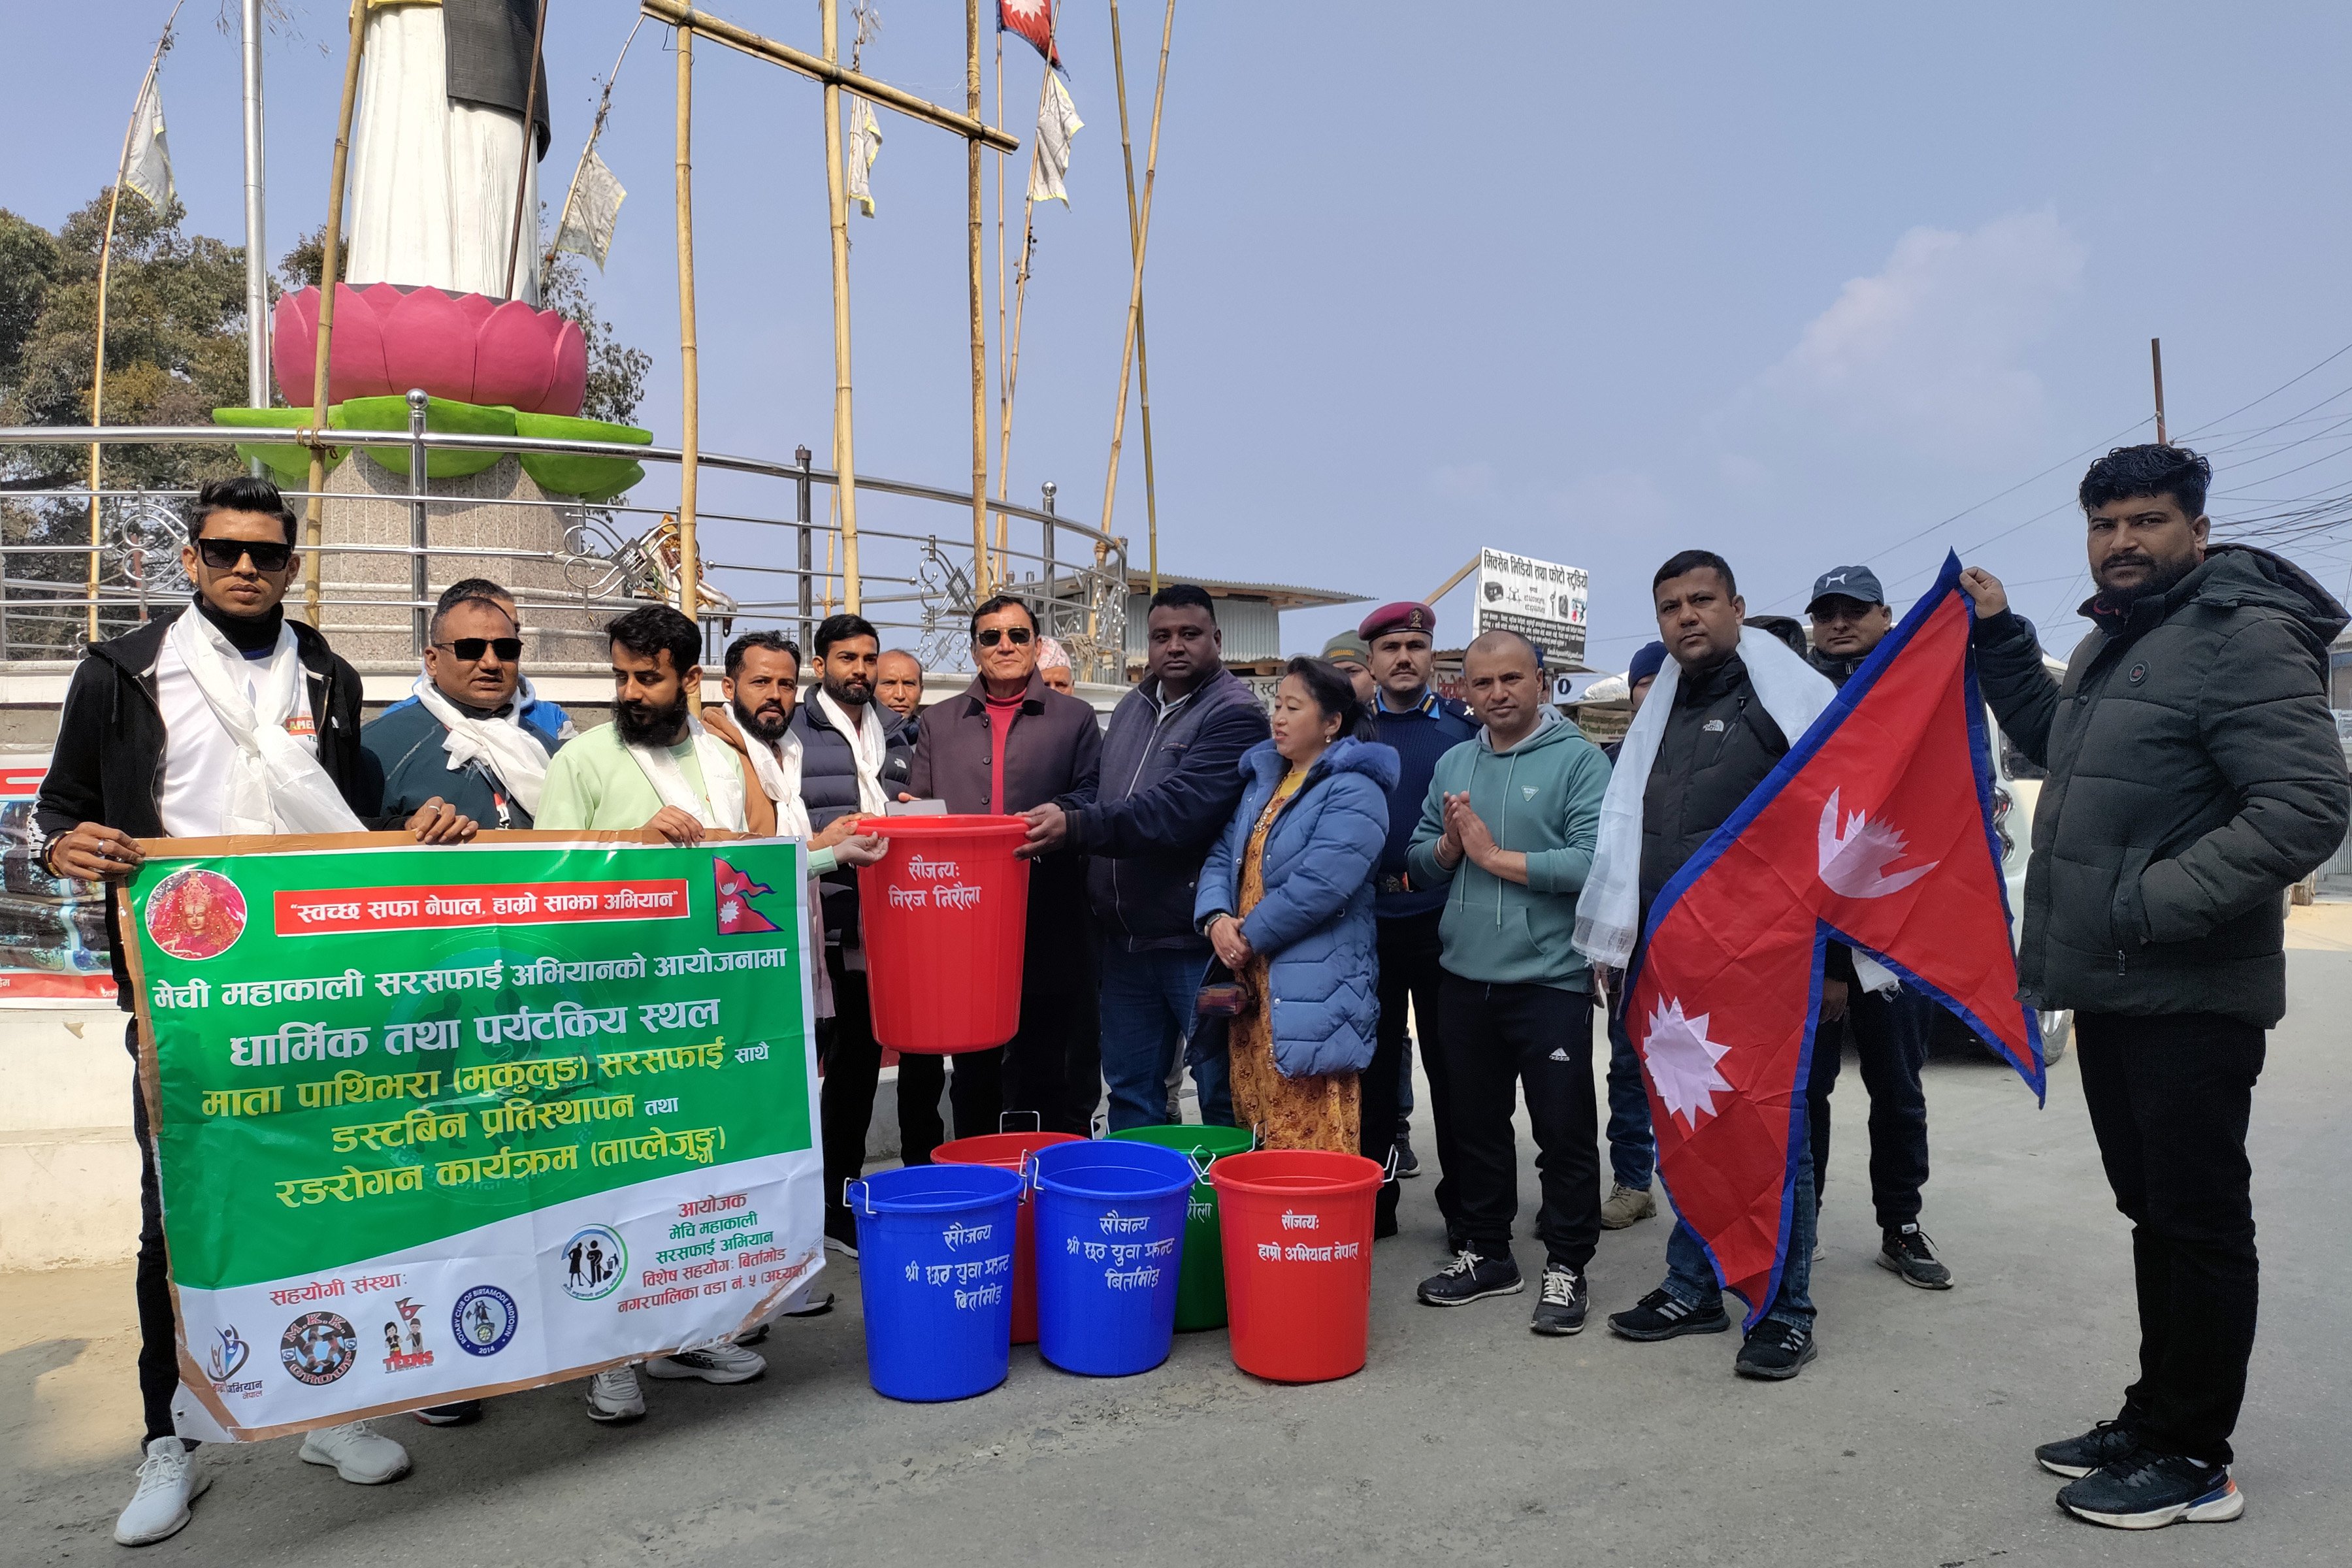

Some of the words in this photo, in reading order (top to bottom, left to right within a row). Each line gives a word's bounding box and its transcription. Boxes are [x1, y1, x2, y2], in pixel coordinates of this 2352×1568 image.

[1535, 565, 1547, 581] तथा
[1549, 565, 1564, 585] फोटो
[1567, 569, 1588, 591] स्टुडियो
[367, 900, 419, 920] सफा
[493, 892, 537, 915] हाम्रो
[544, 894, 598, 913] साझा
[887, 884, 928, 912] निरज
[932, 881, 982, 911] निरौला
[152, 979, 212, 1009] मेची
[221, 968, 366, 1007] महाकाली
[374, 960, 504, 996] सरसफाई
[511, 953, 647, 987] अभियानको
[653, 947, 788, 979] आयोजनामा
[230, 1021, 371, 1068] धार्मिक
[384, 1019, 461, 1056] तथा
[475, 1001, 628, 1045] पर्यटकिय
[639, 998, 721, 1034] स्थल
[1549, 1053, 1570, 1062] adidas
[201, 1085, 284, 1118] माता
[296, 1070, 441, 1109] पाथिभरा
[598, 1036, 727, 1079] सरसफाई
[734, 1041, 770, 1065] साथै
[332, 1109, 469, 1153] डस्टबिन
[480, 1094, 635, 1141] प्रतिस्थापन
[644, 1097, 679, 1117] तथा
[275, 1165, 424, 1209] रङरोगन
[435, 1146, 579, 1188] कार्यक्रम
[678, 1193, 747, 1218] आयोजक
[669, 1222, 696, 1241] मेचि
[699, 1211, 758, 1234] महाकाली
[1100, 1209, 1150, 1235] सौजन्य
[655, 1239, 715, 1264] सरसफाई
[721, 1231, 774, 1252] अभियान
[943, 1222, 992, 1252] सौजन्य
[1067, 1235, 1080, 1255] श्री
[1111, 1243, 1142, 1267] युवा
[1257, 1241, 1282, 1262] हाम्रो
[1284, 1242, 1333, 1262] अभियान
[1334, 1241, 1360, 1260] नेपाल
[643, 1269, 678, 1288] विशेष
[738, 1247, 787, 1269] बिर्तामोड
[905, 1260, 919, 1282] श्री
[954, 1261, 984, 1285] युवा
[1105, 1265, 1161, 1292] बिर्तामोड
[269, 1279, 346, 1306] सहयोगी
[464, 1292, 473, 1302] OF
[472, 1288, 509, 1303] BIRTAMODE
[617, 1287, 699, 1314] नगरपालिका
[703, 1281, 727, 1296] वडा
[954, 1282, 1003, 1311] बिर्तामोड
[455, 1300, 466, 1318] CLUB
[505, 1301, 515, 1337] MIDTOWN
[454, 1319, 468, 1345] ROTARY
[383, 1350, 434, 1371] TEENS
[478, 1345, 496, 1354] 2014
[289, 1350, 353, 1386] GROUP
[242, 1390, 263, 1399] नेपाल
